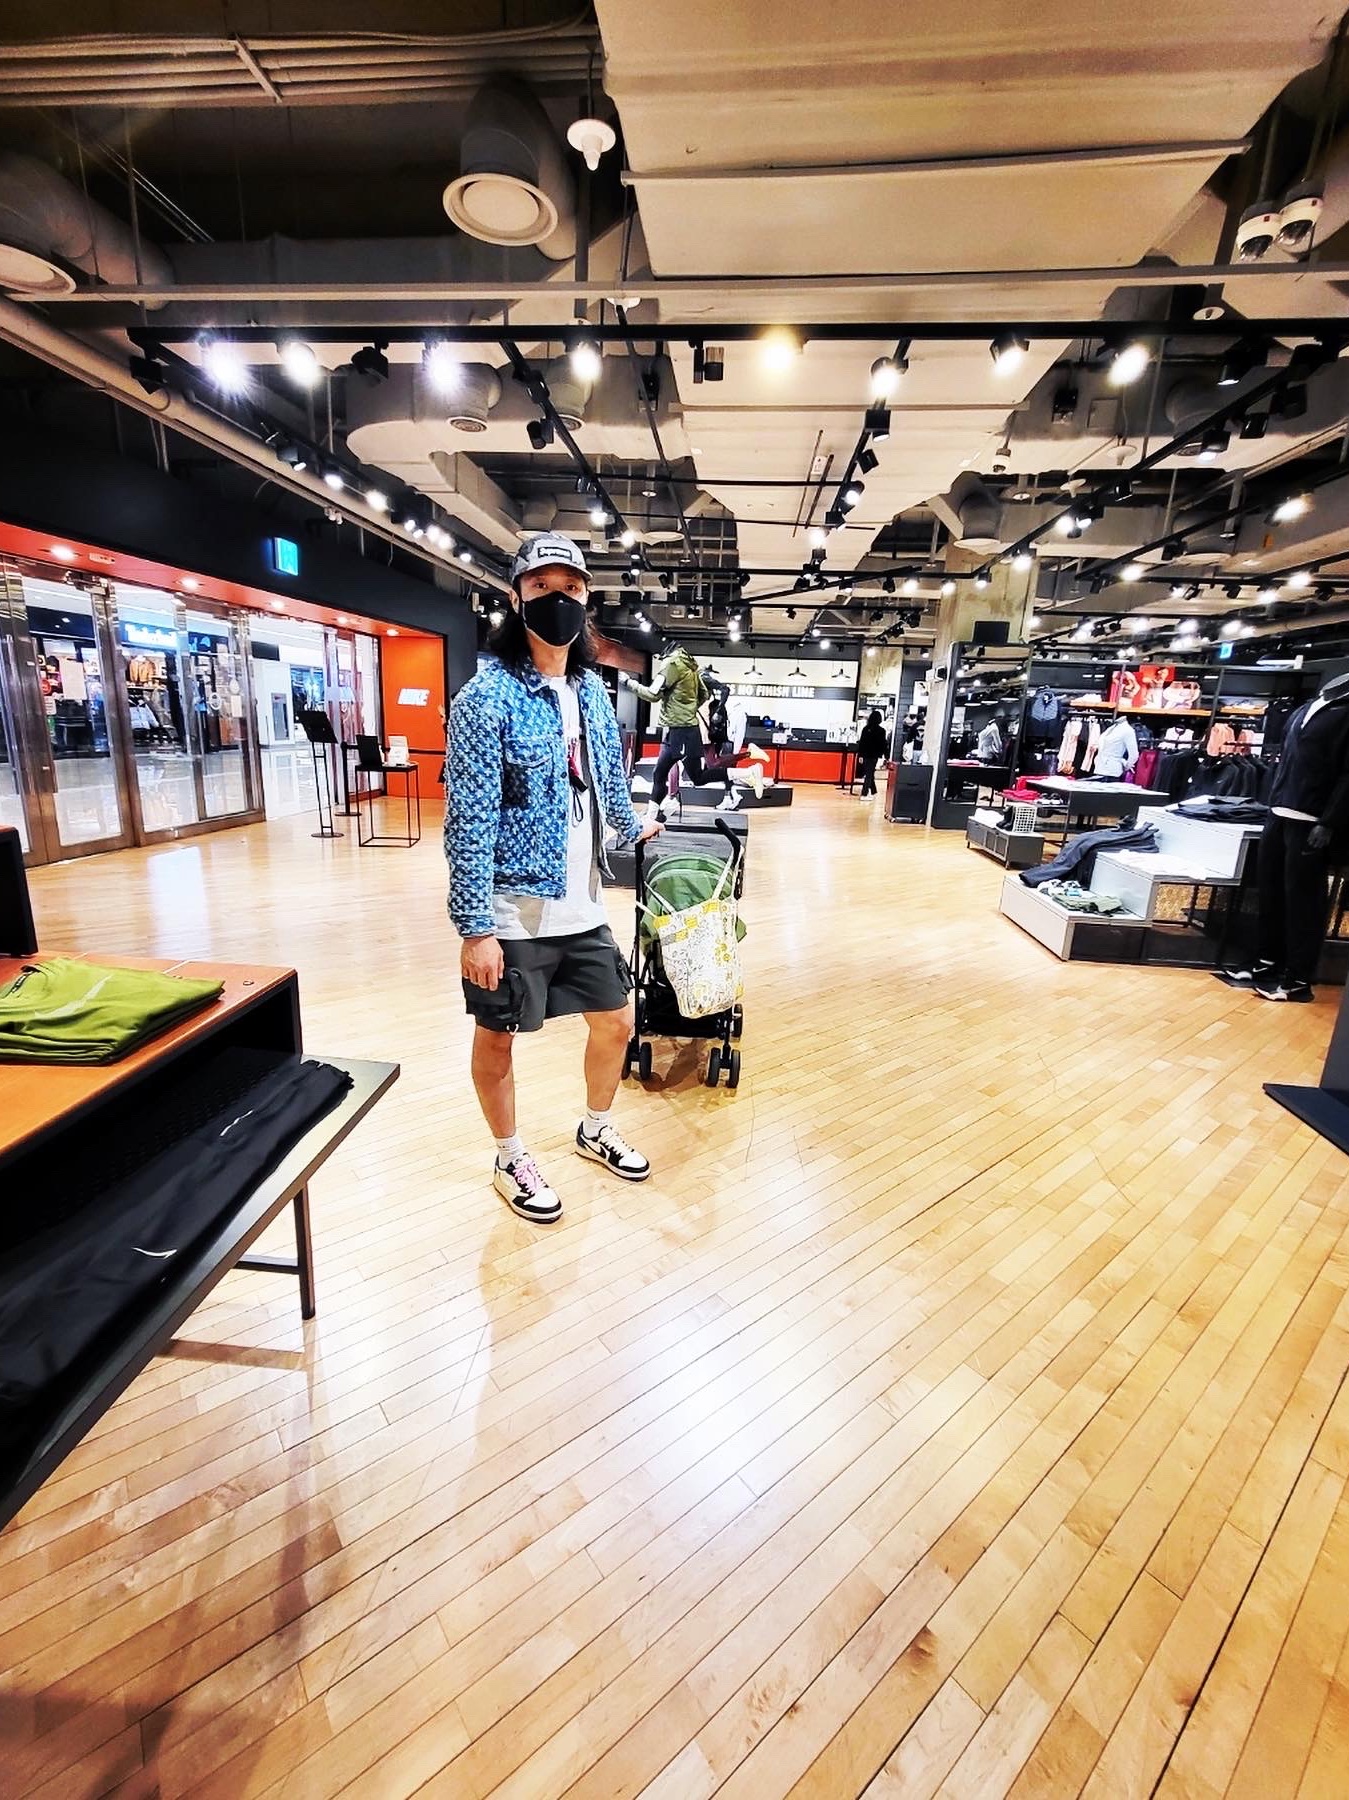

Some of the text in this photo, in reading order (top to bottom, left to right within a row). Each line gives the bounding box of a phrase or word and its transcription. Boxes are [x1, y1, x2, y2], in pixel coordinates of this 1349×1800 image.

[397, 688, 430, 707] NIKE
[738, 685, 754, 696] NO
[756, 685, 789, 698] FINISH
[792, 687, 815, 698] LINE
